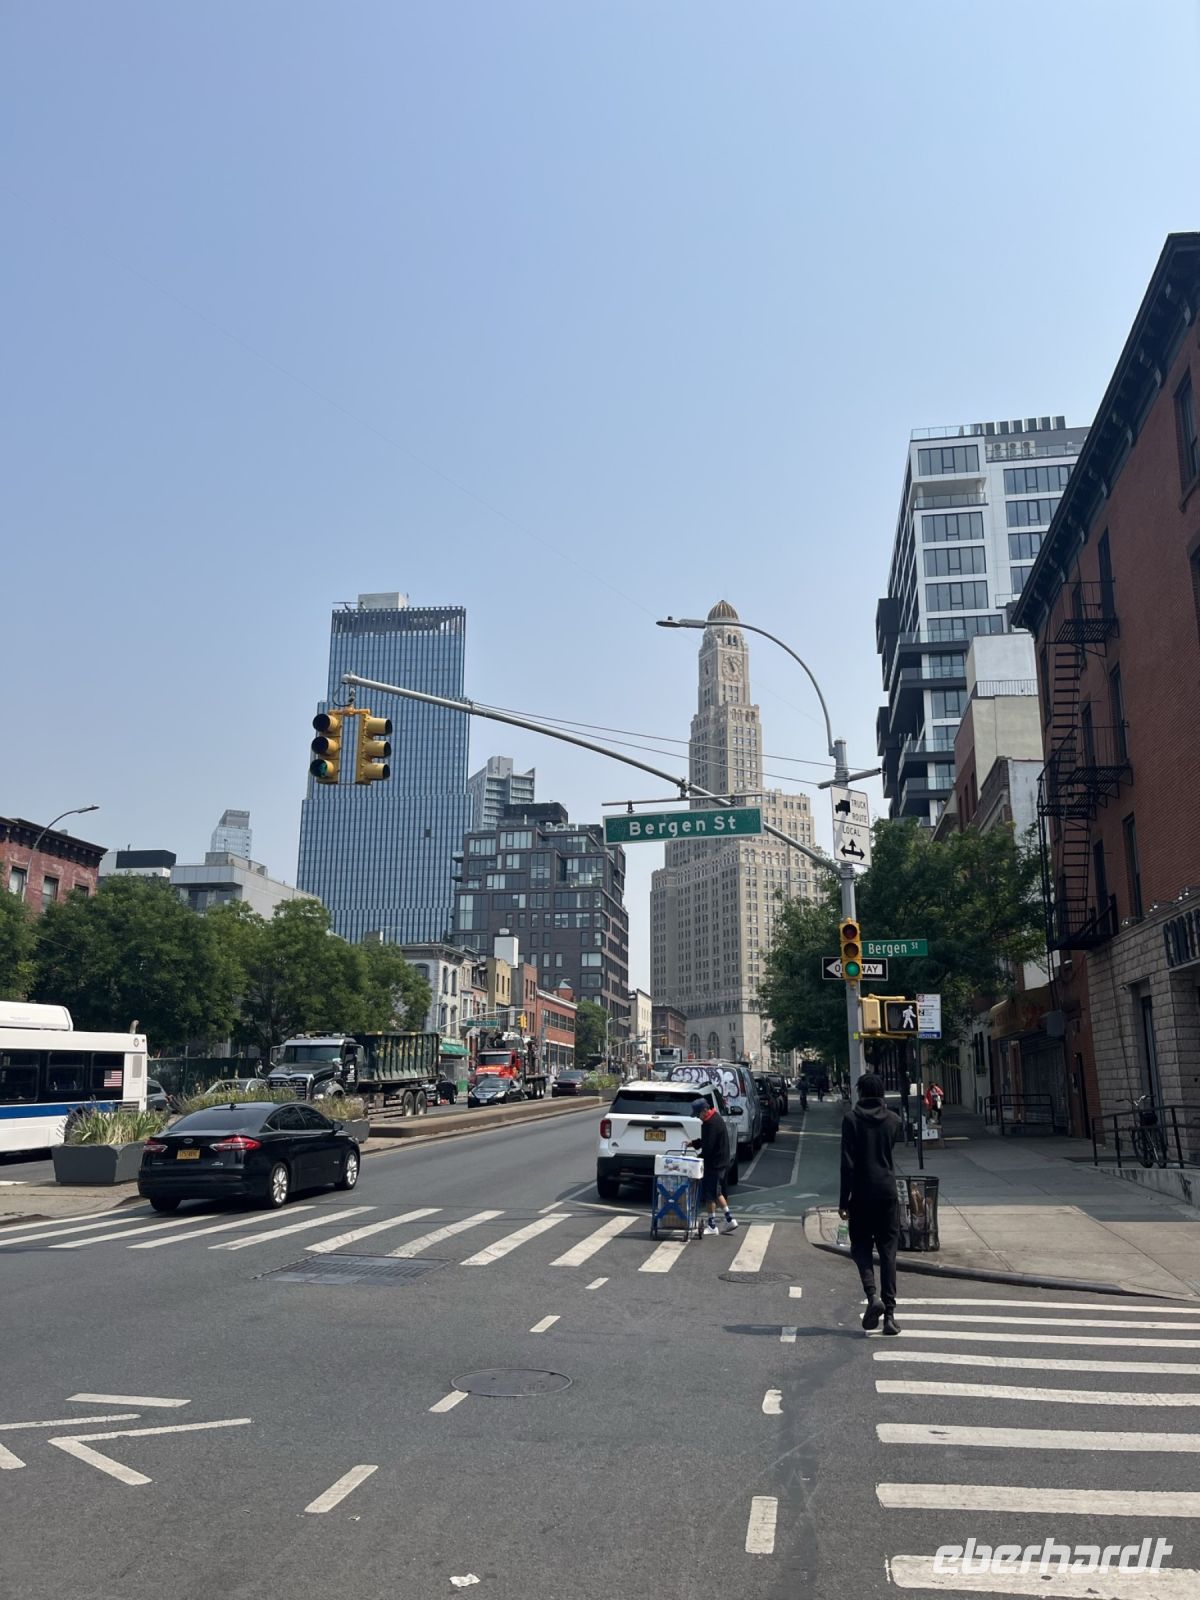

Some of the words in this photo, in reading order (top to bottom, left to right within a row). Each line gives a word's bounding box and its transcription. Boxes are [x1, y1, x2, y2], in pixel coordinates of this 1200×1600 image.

[851, 799, 866, 809] TRUCK
[852, 813, 867, 823] ROUTE
[629, 819, 706, 837] Bergen
[713, 815, 736, 830] St
[842, 825, 861, 837] LOCAL
[868, 943, 907, 957] Bergen
[911, 941, 918, 949] St
